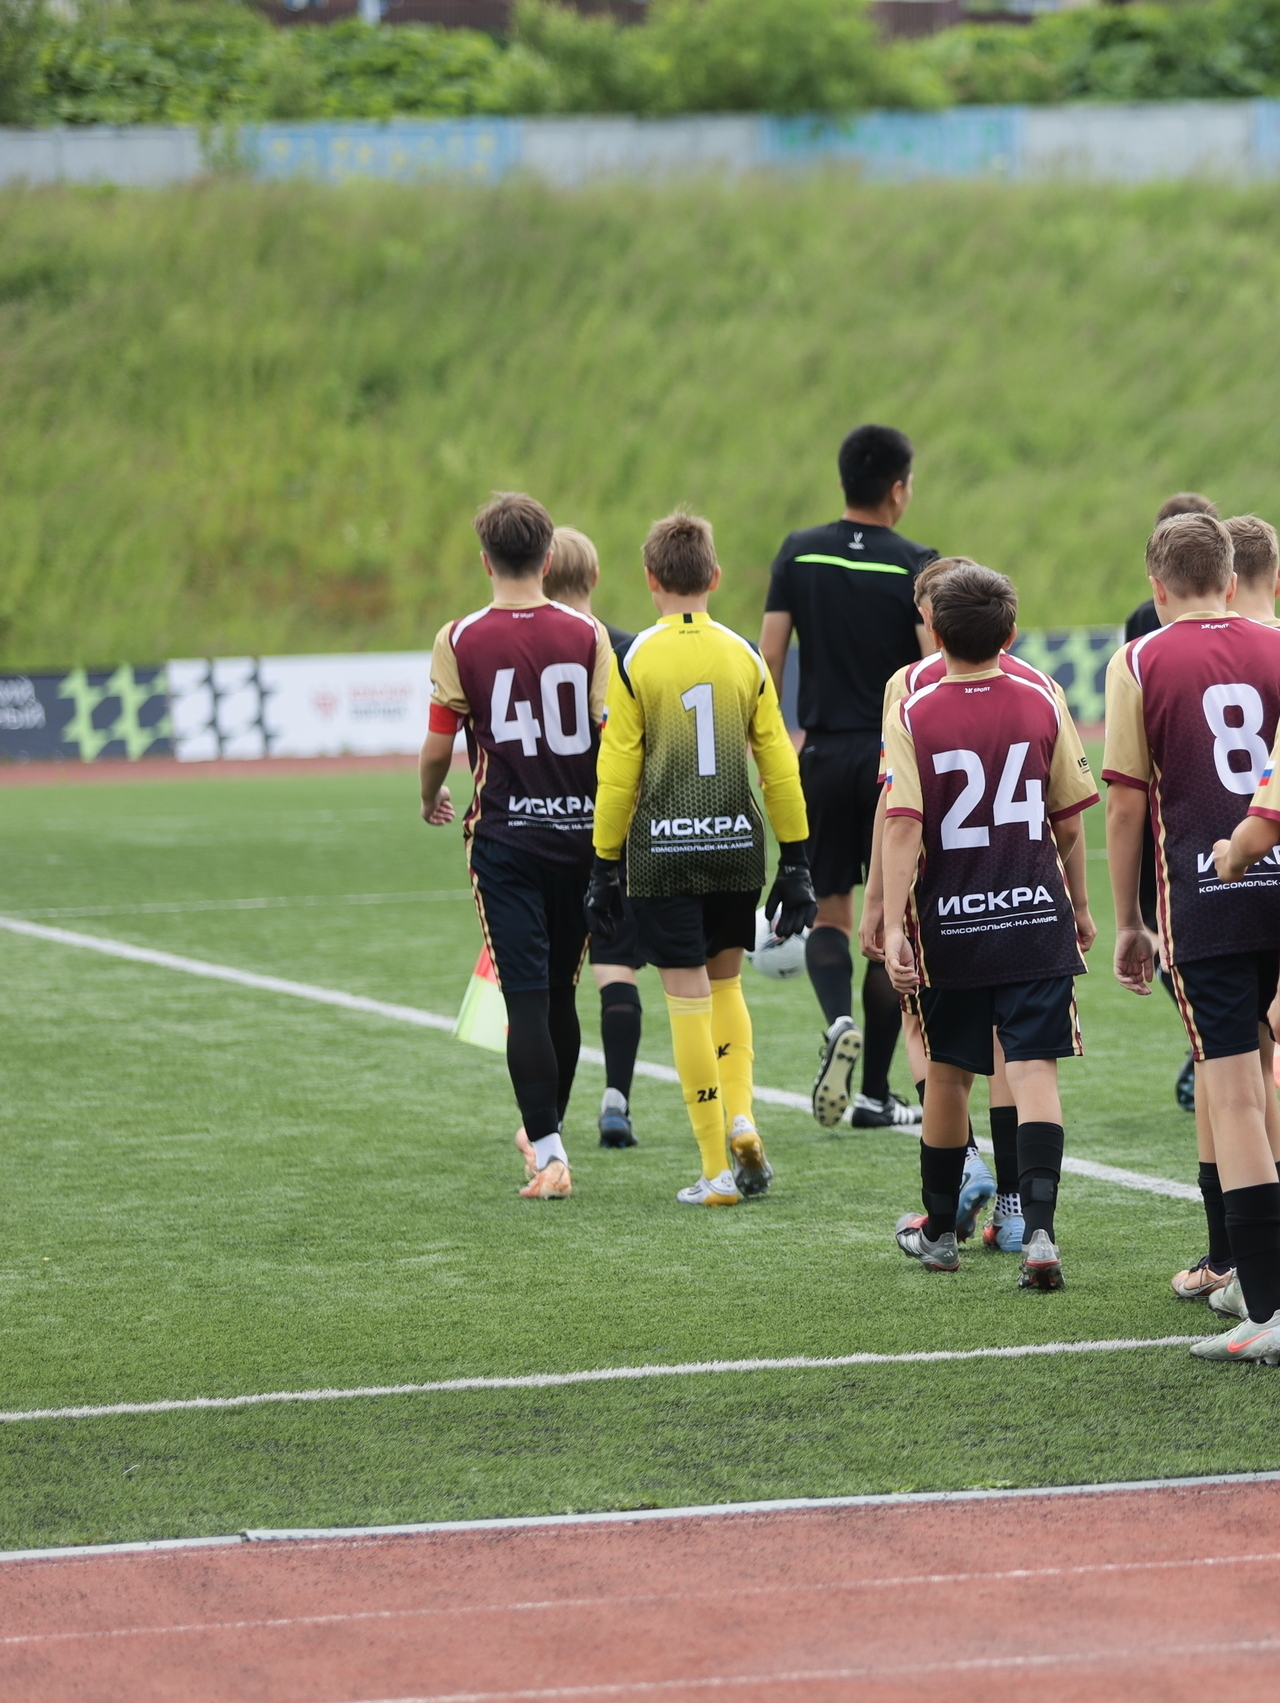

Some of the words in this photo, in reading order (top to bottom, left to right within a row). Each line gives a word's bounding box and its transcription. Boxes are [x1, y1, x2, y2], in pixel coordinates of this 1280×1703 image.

[490, 662, 592, 757] 40
[680, 682, 716, 776] 1
[1202, 683, 1271, 795] 8
[508, 795, 596, 816] ИСКРА
[932, 741, 1045, 851] 24
[650, 813, 752, 837] ИСКРА
[938, 885, 1054, 917] ИСКРА
[940, 915, 1058, 936] КОМСОМОЛЬСК-НА-АМУРЕ
[714, 1043, 731, 1060] K
[697, 1087, 718, 1103] 2K
